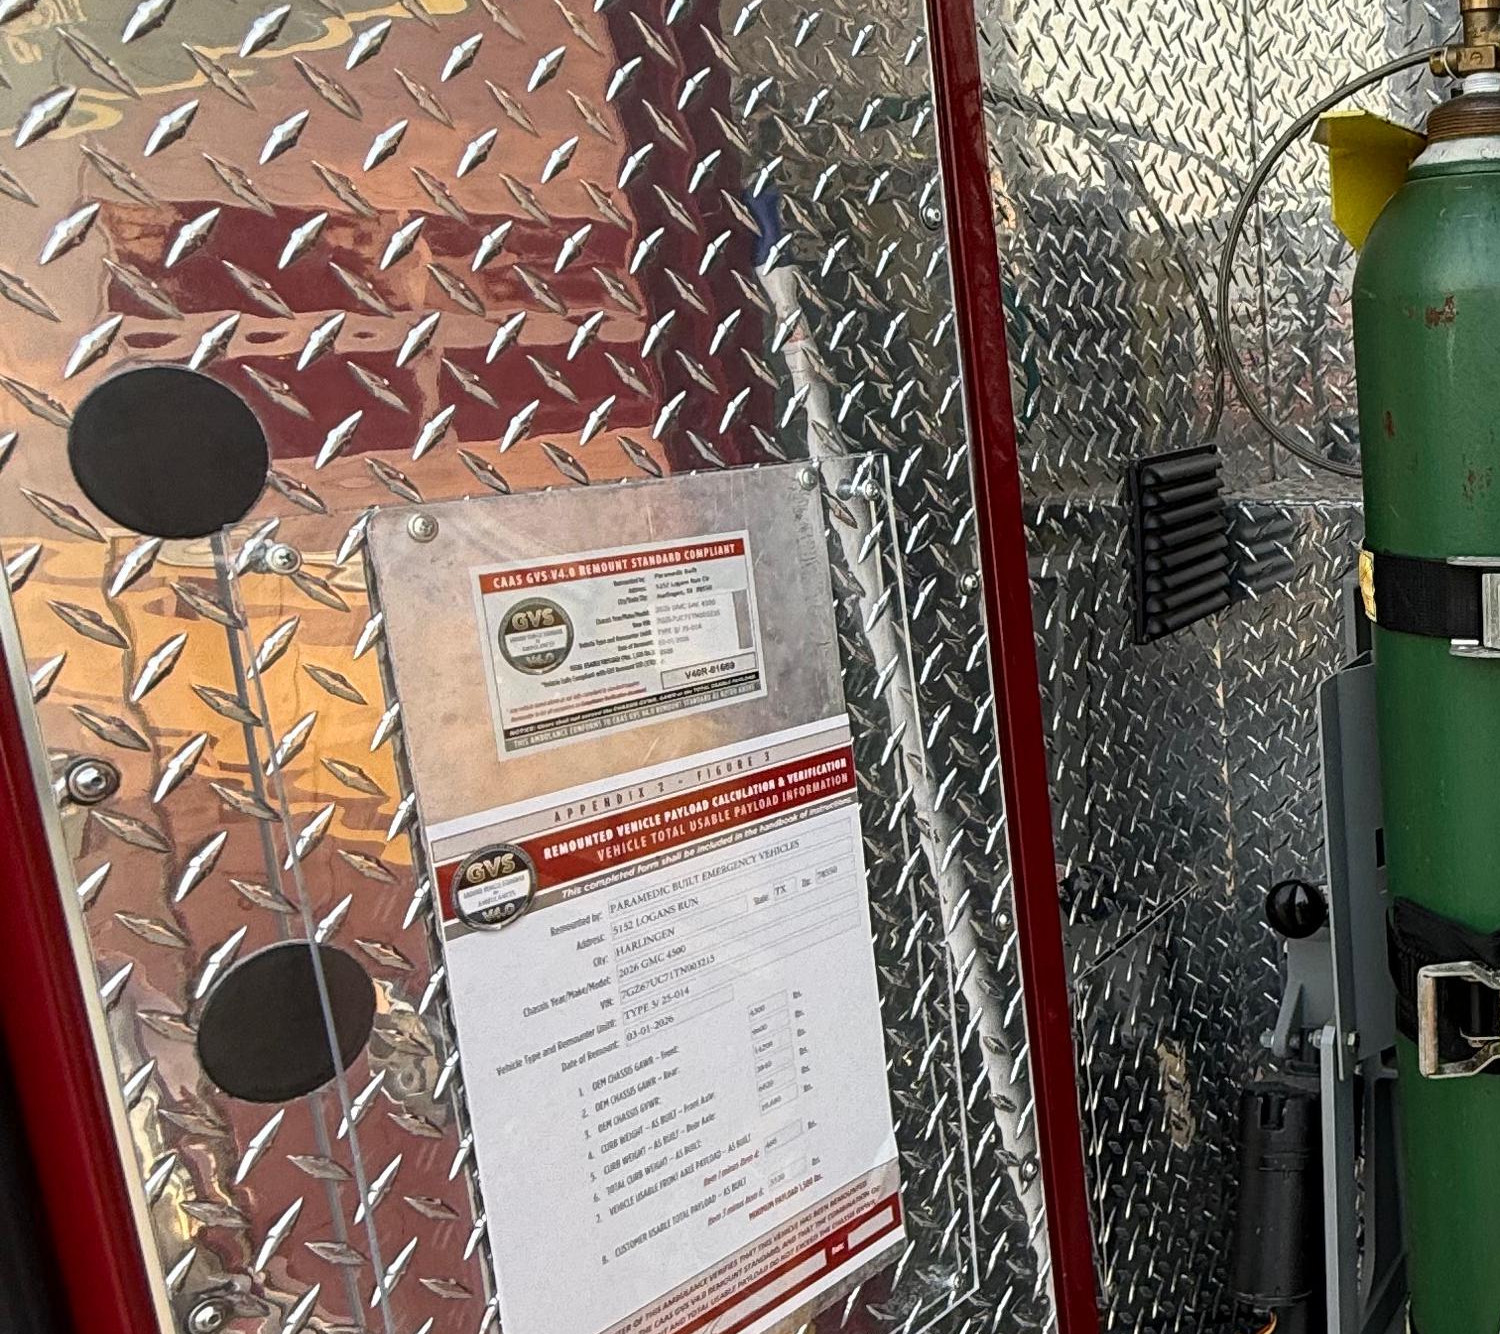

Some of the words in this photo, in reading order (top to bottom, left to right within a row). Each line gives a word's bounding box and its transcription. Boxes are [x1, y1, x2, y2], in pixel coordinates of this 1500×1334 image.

[492, 573, 523, 590] CAAS
[524, 569, 548, 585] GVS
[550, 565, 576, 581] V4.0
[577, 558, 628, 577] REMOUNT
[630, 550, 681, 569] STANDARD
[682, 542, 735, 561] COMPLIANT
[510, 606, 555, 632] GVS
[552, 785, 645, 823] APPENDIX
[656, 780, 665, 793] 2
[696, 755, 753, 782] FIGURE
[763, 750, 770, 762] 3
[542, 827, 613, 860] REMOUNTED
[616, 812, 661, 838] VEHICLE
[663, 798, 709, 823] PAYLOAD
[710, 778, 776, 808] CALCULATION
[777, 775, 785, 788] &
[786, 756, 847, 785] VERIFICATION
[596, 834, 647, 862] VEHICLE
[649, 822, 686, 845] TOTAL
[688, 807, 731, 833] USABLE
[733, 792, 779, 819] PAYLOAD
[781, 771, 848, 803] INFORMATION
[464, 851, 517, 887] GVS
[560, 883, 583, 900] This
[582, 866, 635, 893] completed
[640, 858, 659, 874] form
[660, 850, 682, 867] shall
[695, 834, 730, 855] included
[744, 825, 758, 839] the
[758, 812, 798, 834] handbook
[608, 883, 670, 914] PARAMEDIC
[671, 873, 699, 892] BUILT
[700, 853, 756, 882] EMERGENCY
[758, 838, 799, 861] VEHICLES
[481, 900, 516, 925] V4.0
[612, 919, 633, 936] 5152
[634, 903, 675, 927] LOGANS
[676, 895, 699, 912] RUN
[615, 925, 675, 957] HARLINGEN
[618, 961, 639, 978] 2026
[640, 951, 665, 970] GMC
[624, 1001, 649, 1021] TYPE
[660, 984, 690, 1005] 25-014
[560, 1055, 578, 1072] Date
[591, 1075, 607, 1092] OEM
[594, 1096, 610, 1113] OEM
[597, 1117, 613, 1134] OEM
[644, 1303, 662, 1322] THIS
[662, 1274, 709, 1311] AMBULANCE
[669, 1314, 686, 1332] AND
